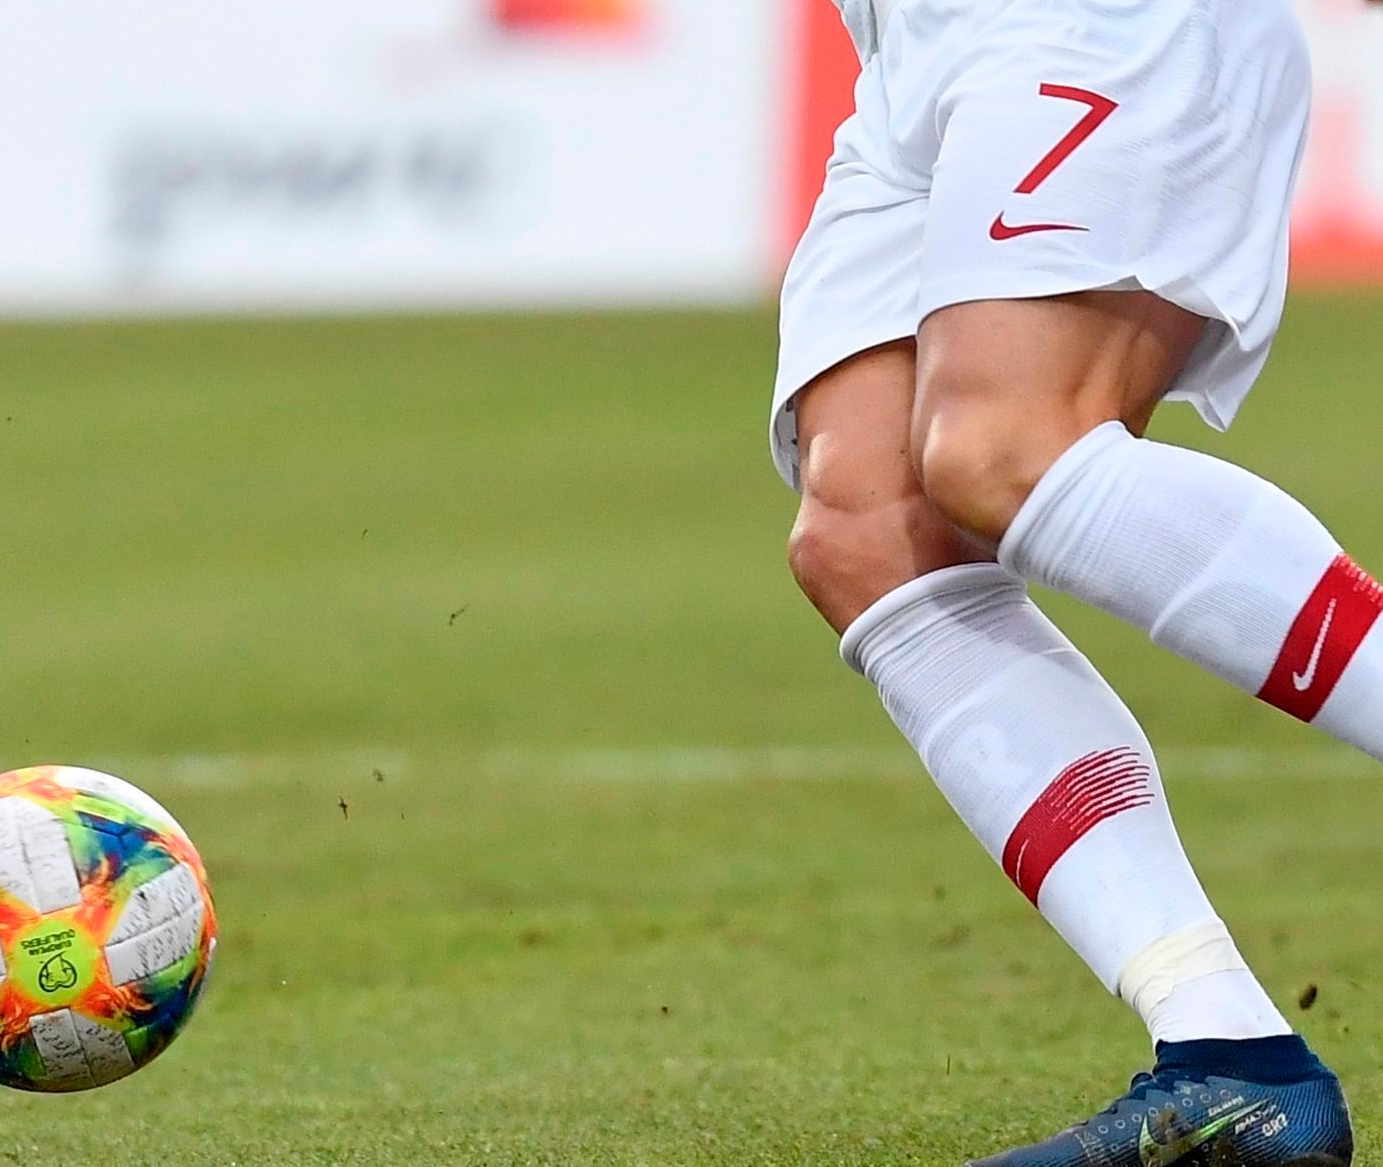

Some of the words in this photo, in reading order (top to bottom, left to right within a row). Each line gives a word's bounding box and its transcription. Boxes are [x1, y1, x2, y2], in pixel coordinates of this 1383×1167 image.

[1014, 82, 1119, 196] 7
[20, 928, 76, 950] QUALIFIERS
[28, 939, 73, 956] EUROPEAN
